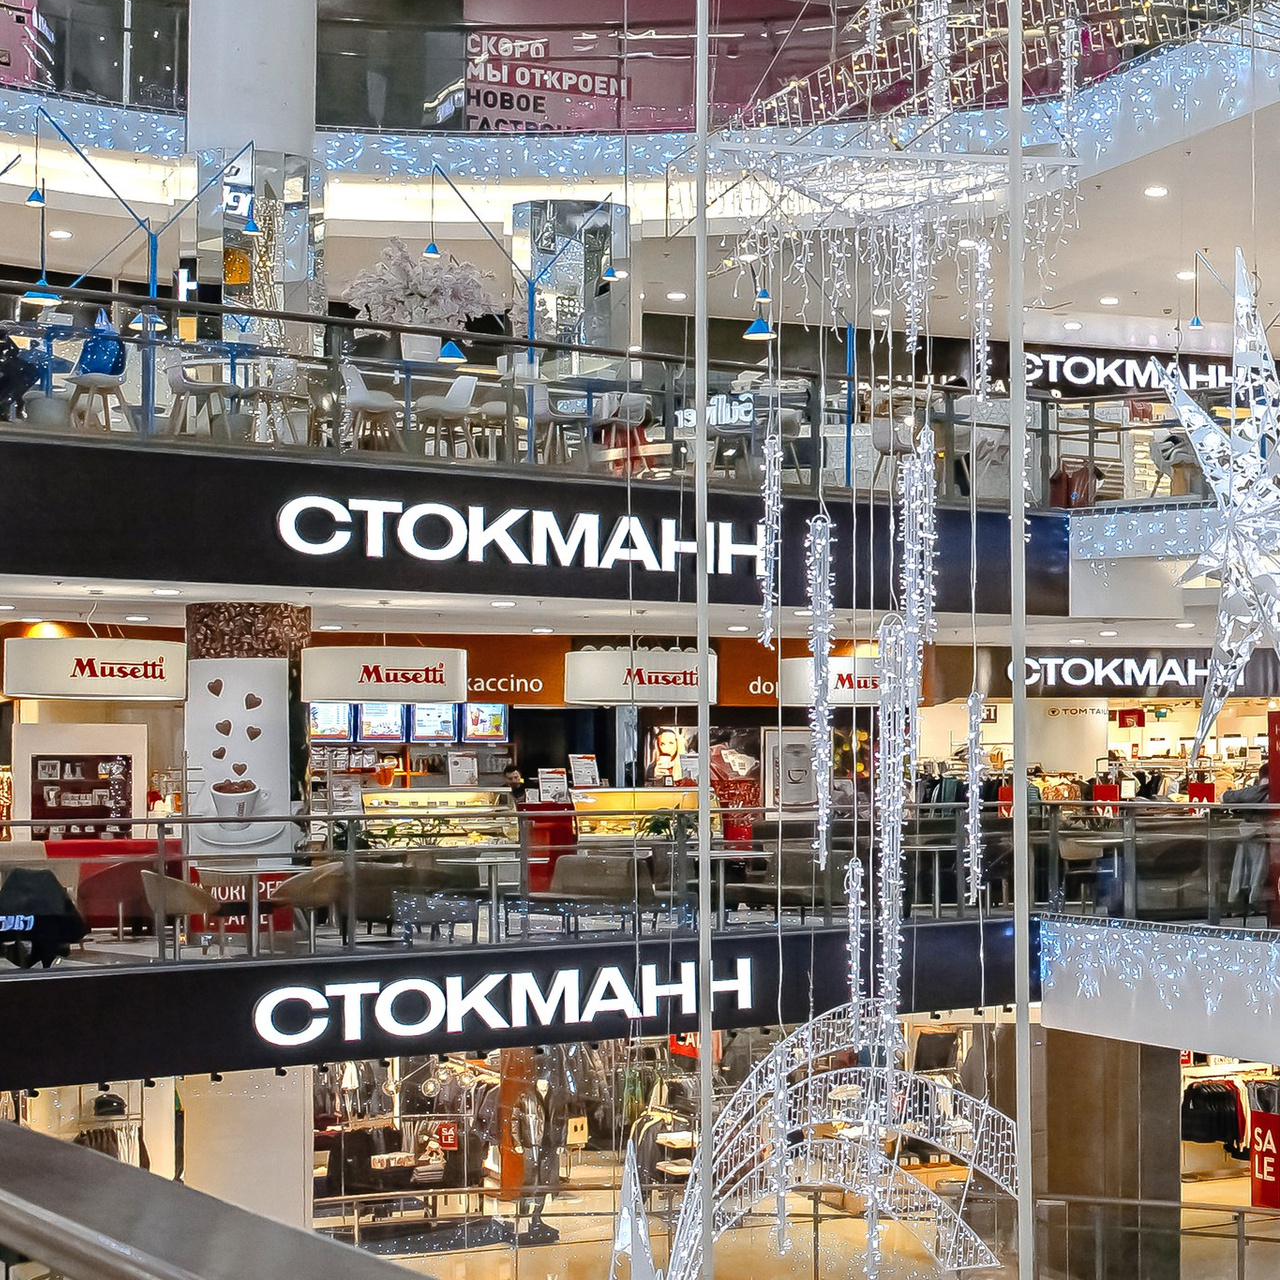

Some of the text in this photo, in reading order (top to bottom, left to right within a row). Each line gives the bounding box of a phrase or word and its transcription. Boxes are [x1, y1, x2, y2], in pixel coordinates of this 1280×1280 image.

[467, 33, 546, 58] СКОРО
[467, 62, 509, 84] МЫ
[467, 89, 546, 114] НОВОЕ
[277, 494, 770, 577] СТОКМАНН
[70, 656, 166, 680] Musetti
[358, 662, 446, 685] Musetti
[1061, 708, 1088, 716] TOM
[253, 956, 753, 1047] СТОКМАНН
[1253, 1126, 1277, 1154] SA
[1254, 1157, 1275, 1182] LE
